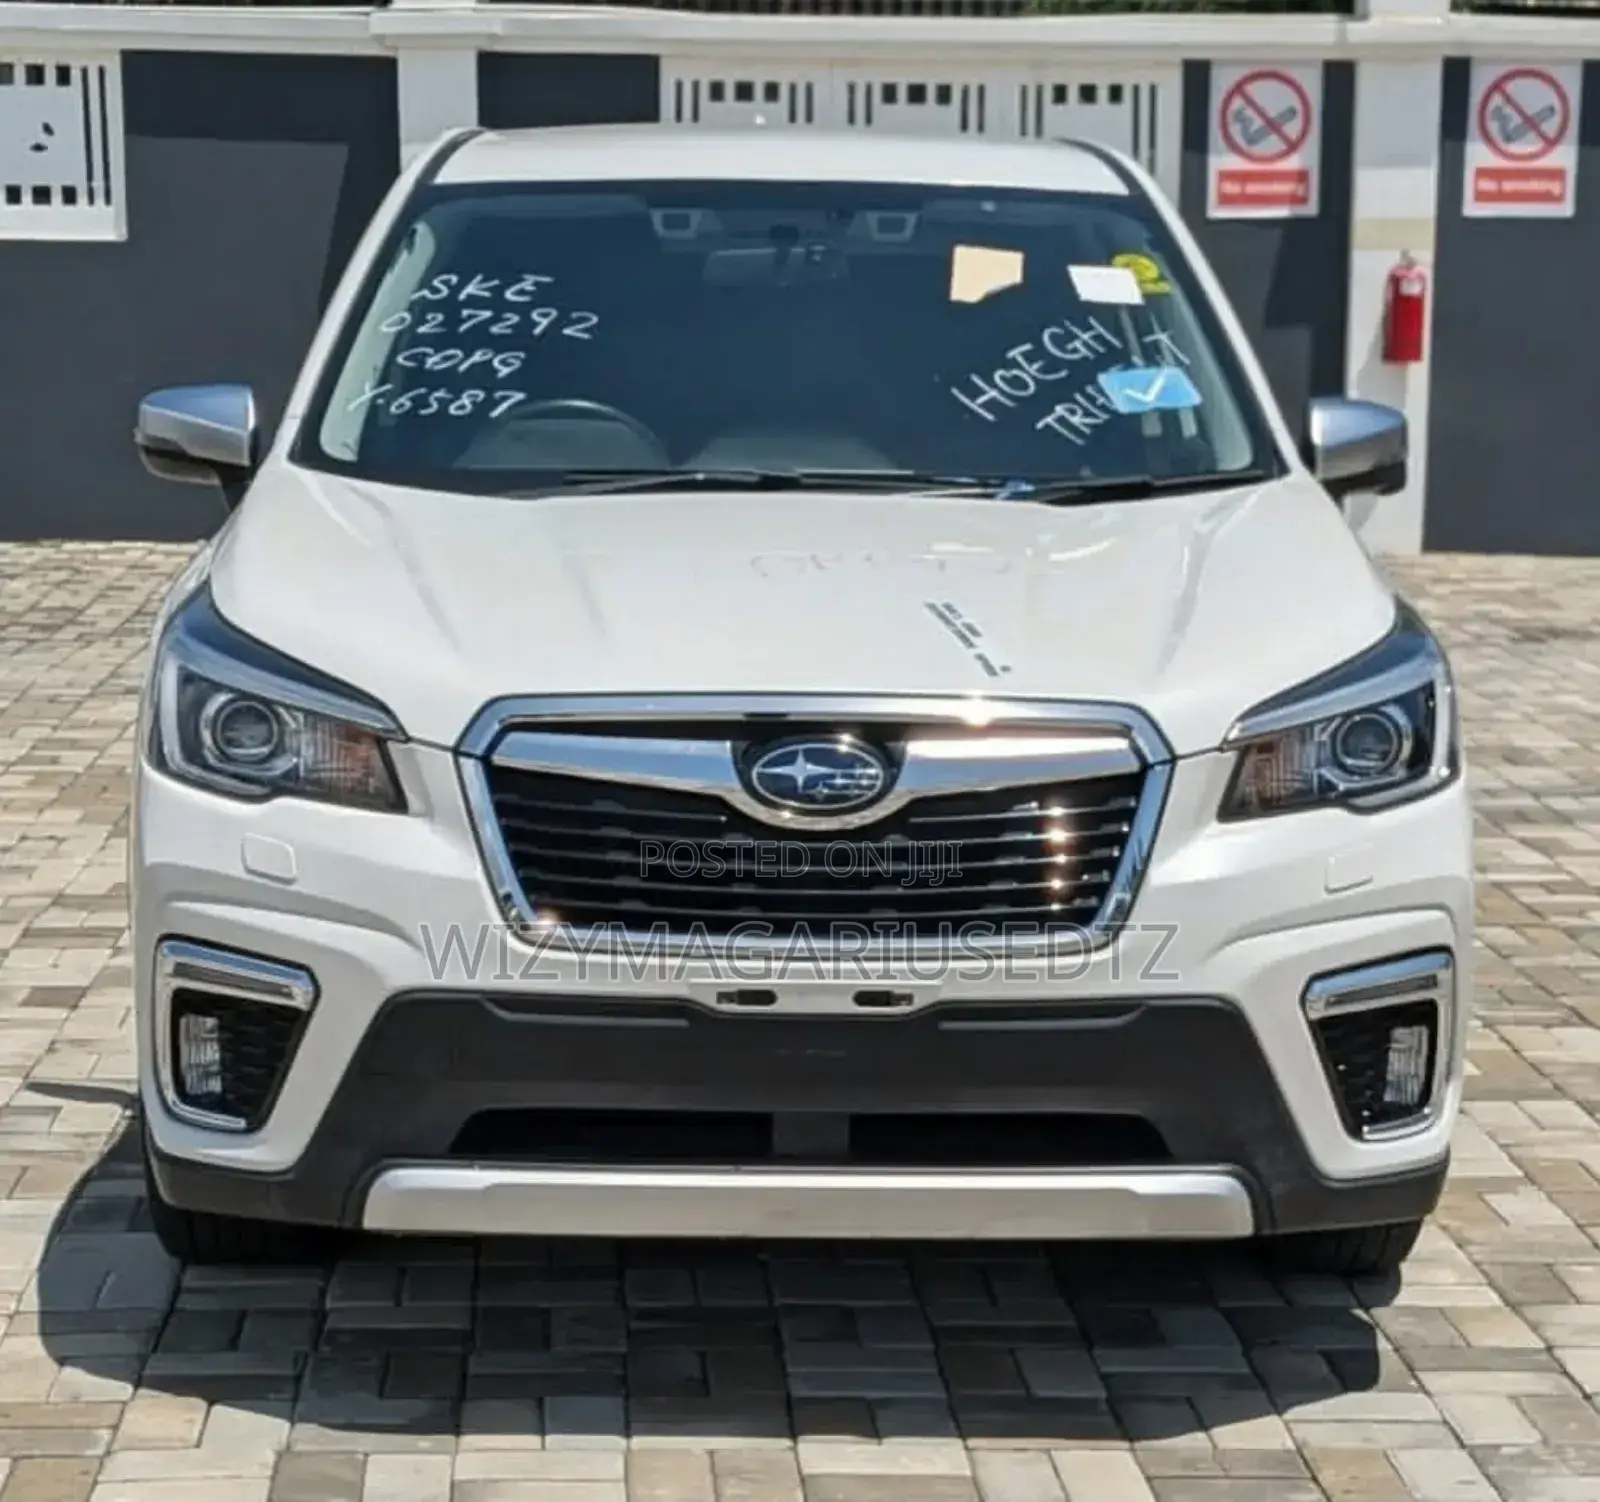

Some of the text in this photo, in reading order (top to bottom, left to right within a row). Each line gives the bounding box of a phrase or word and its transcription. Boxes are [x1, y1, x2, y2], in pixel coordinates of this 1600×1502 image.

[410, 273, 554, 302] SKE
[379, 307, 599, 339] 027292
[950, 315, 1123, 422] HOEGH
